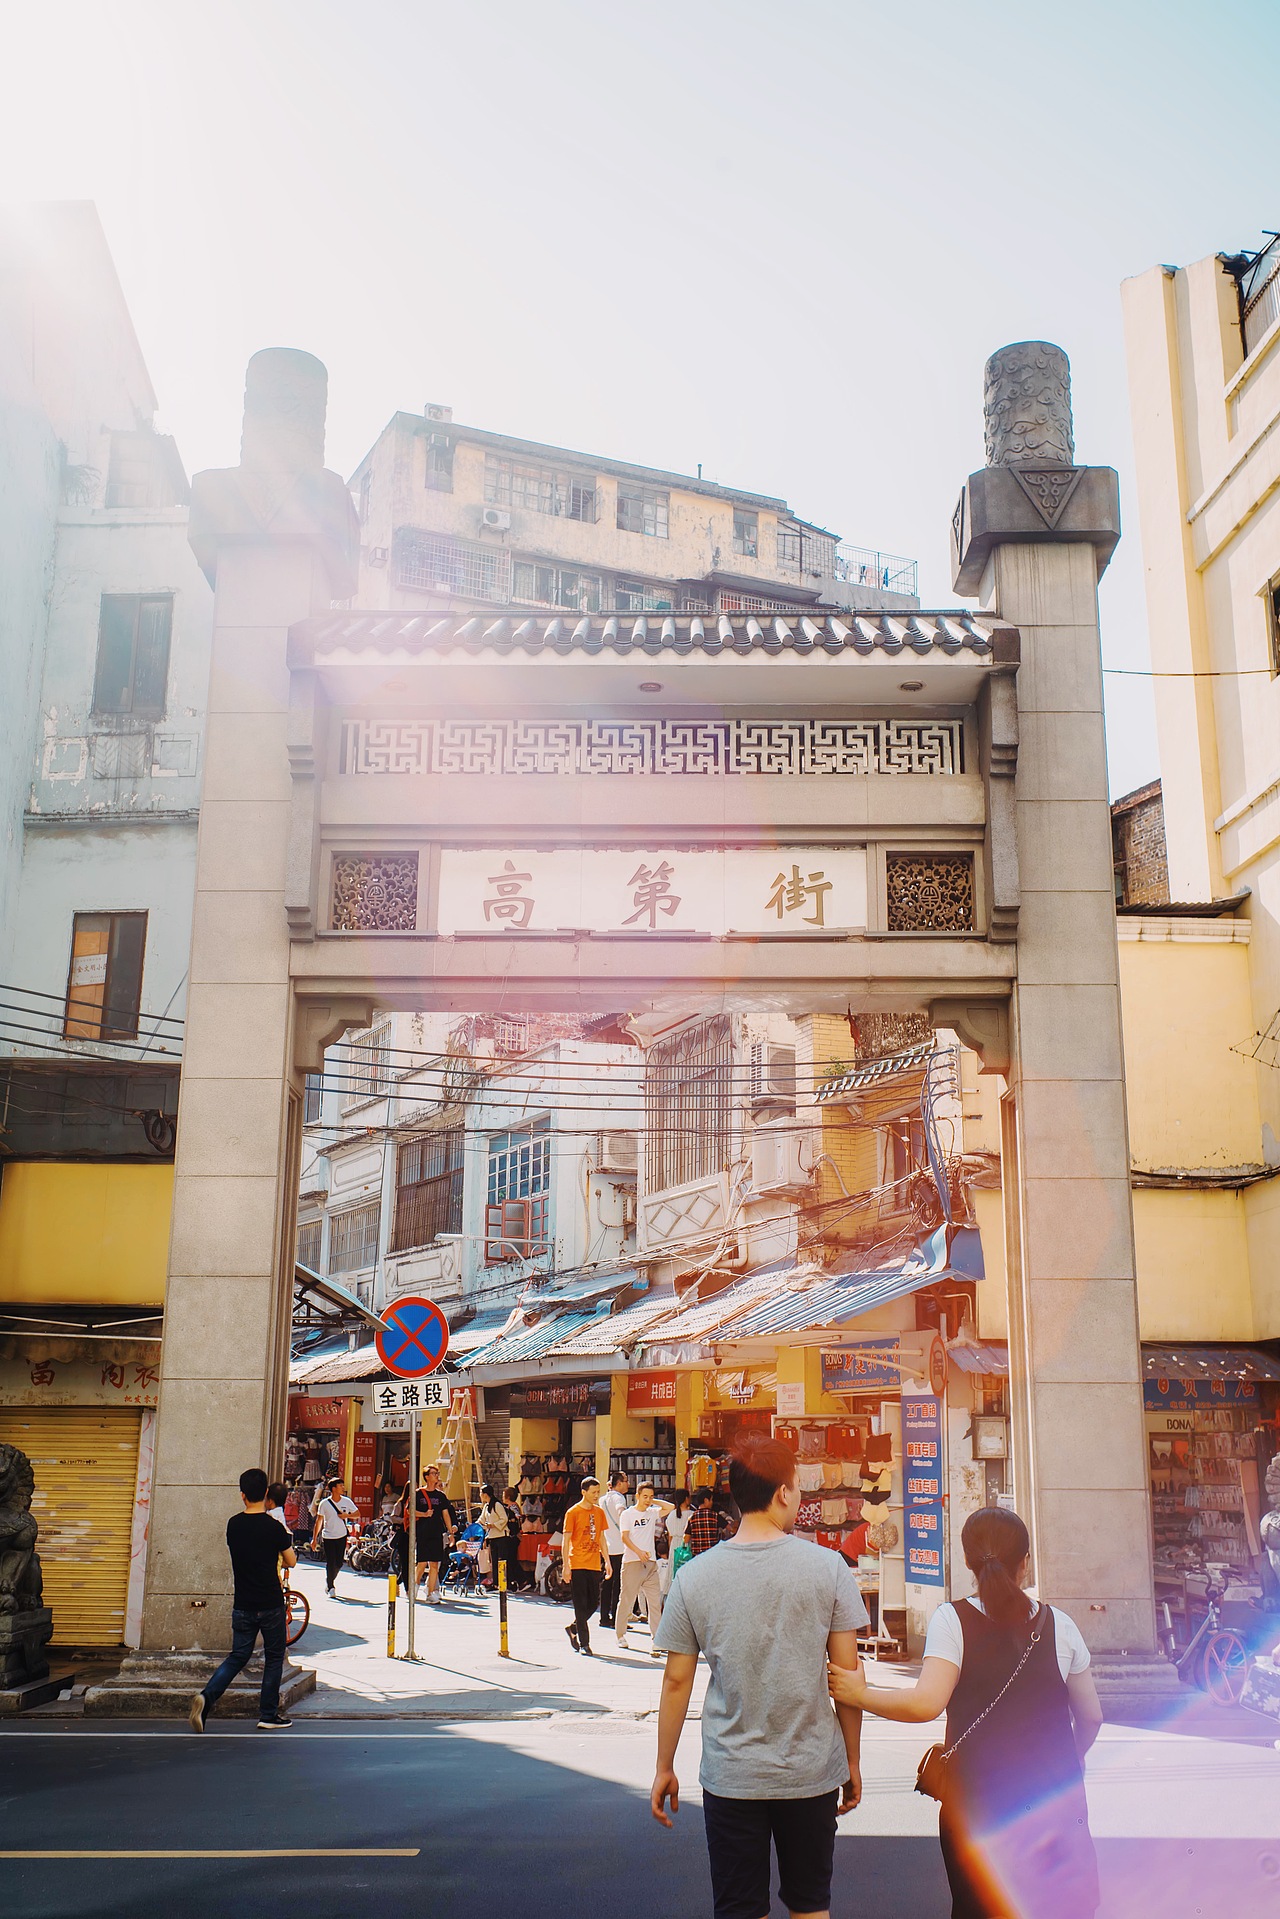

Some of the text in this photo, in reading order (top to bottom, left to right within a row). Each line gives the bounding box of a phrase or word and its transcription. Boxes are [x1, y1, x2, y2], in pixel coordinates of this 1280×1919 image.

[481, 859, 834, 929] 高第街
[379, 1383, 443, 1409] 全路段
[906, 1403, 937, 1418] 工厂直销
[909, 1548, 940, 1566] 批发零售
